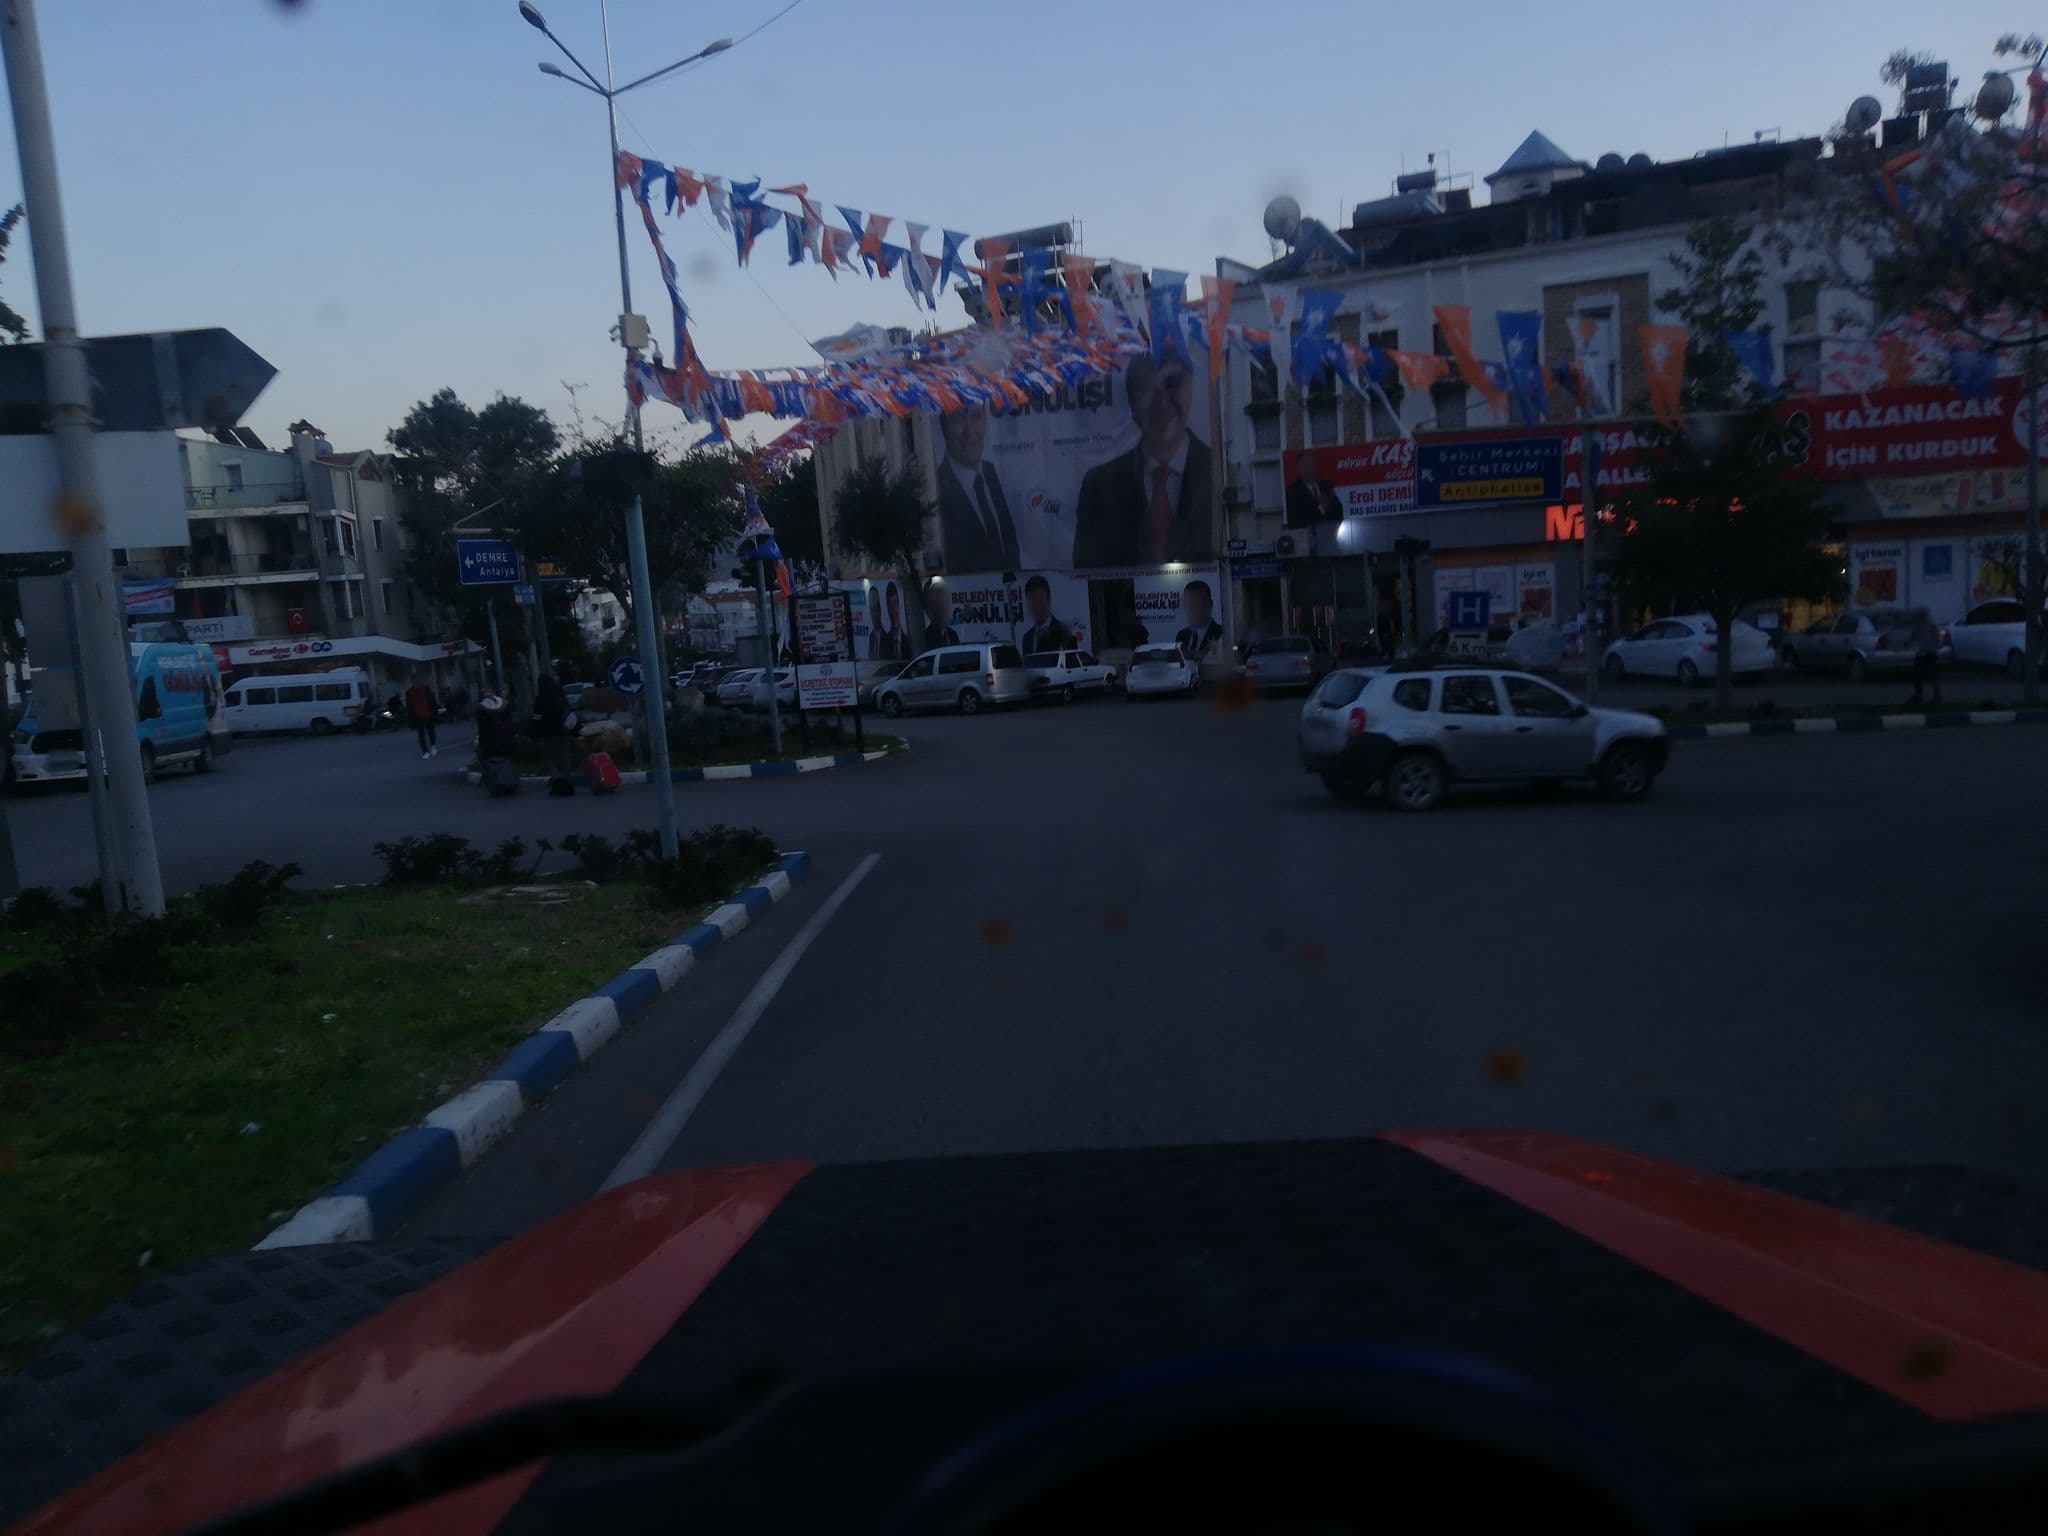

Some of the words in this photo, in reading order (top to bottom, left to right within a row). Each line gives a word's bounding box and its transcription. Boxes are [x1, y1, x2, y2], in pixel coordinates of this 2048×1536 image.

[1824, 396, 2004, 431] KAZANACAK
[1371, 440, 1415, 470] KAŞ
[1491, 446, 1558, 460] Merkezi
[1826, 440, 1878, 470] İÇİN
[1888, 434, 1998, 464] KURDUK
[1457, 461, 1539, 476] CENTRUM
[476, 552, 508, 563] DEMRE
[480, 566, 515, 578] Antalya
[952, 587, 1004, 605] BELEDİYE
[1458, 597, 1481, 624] H
